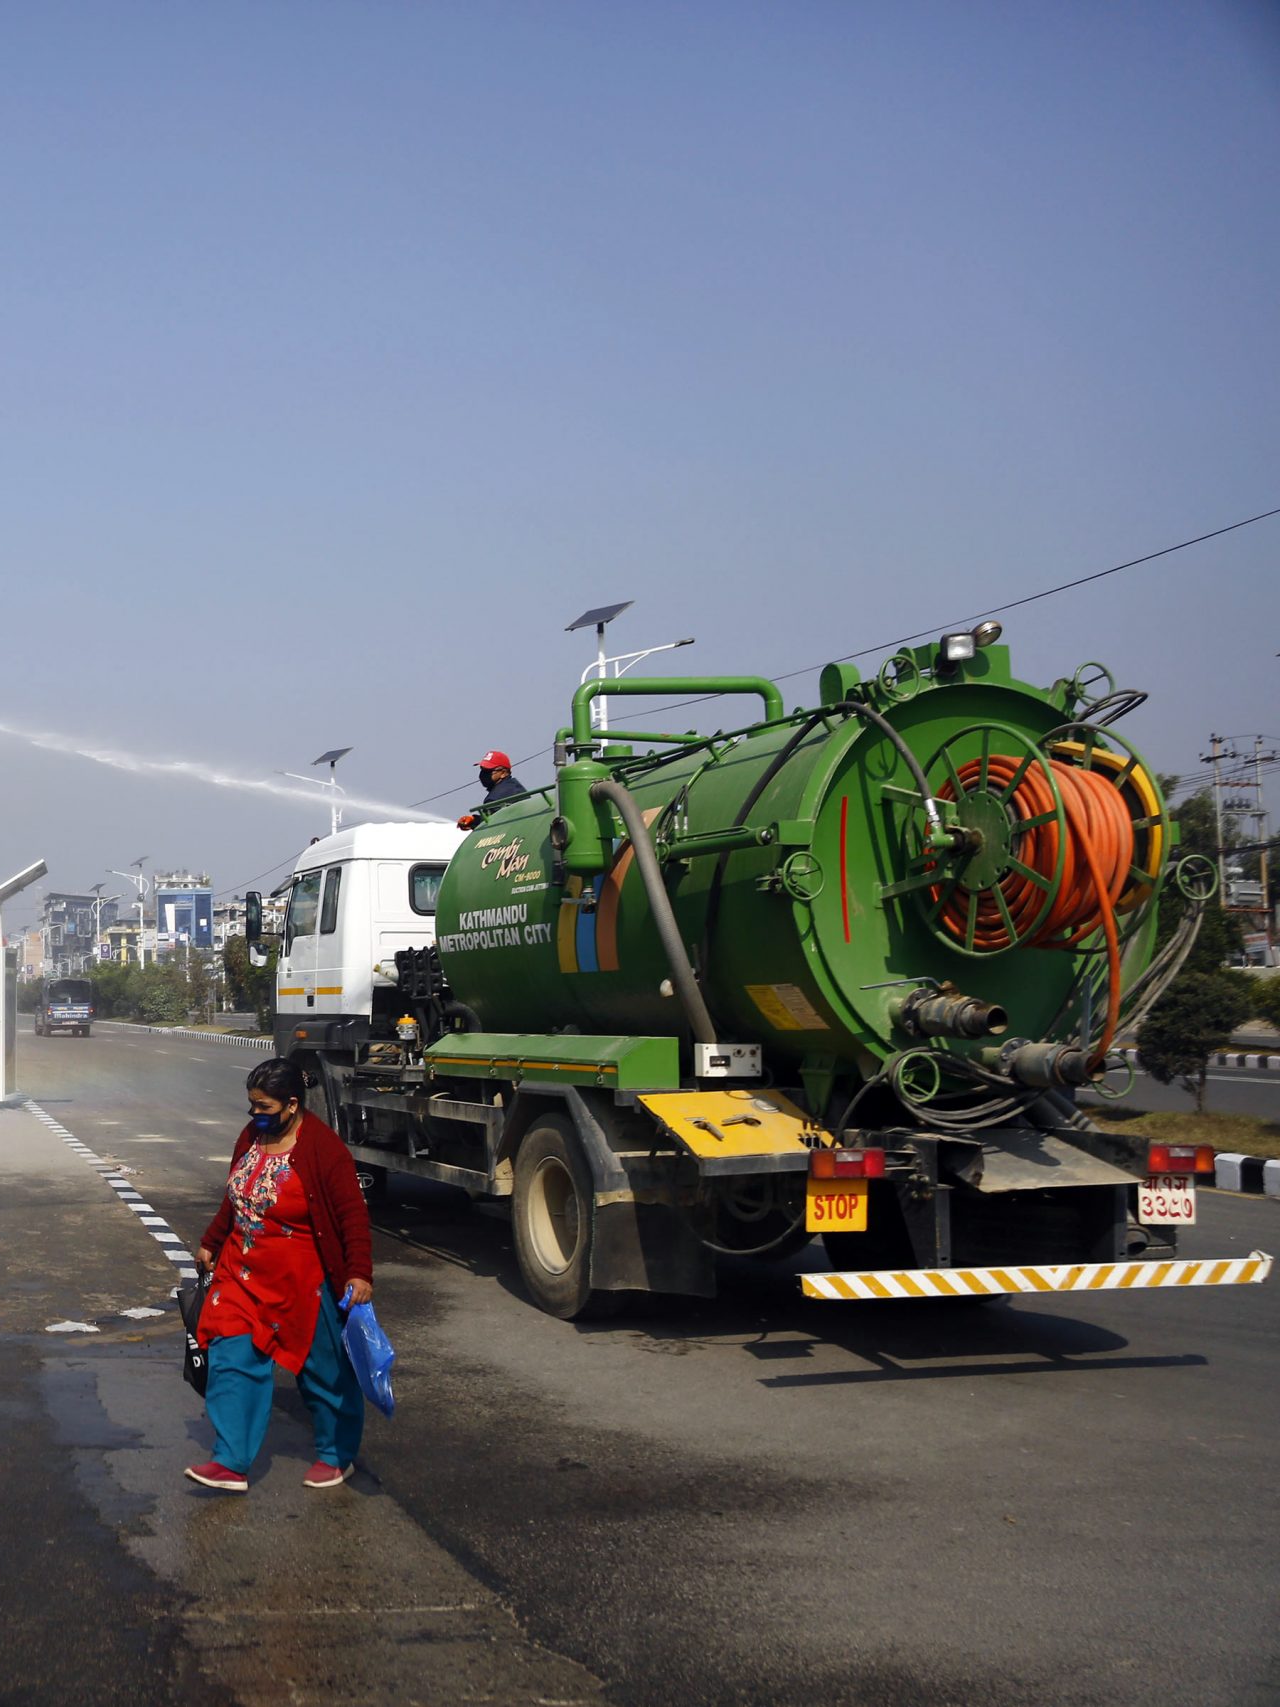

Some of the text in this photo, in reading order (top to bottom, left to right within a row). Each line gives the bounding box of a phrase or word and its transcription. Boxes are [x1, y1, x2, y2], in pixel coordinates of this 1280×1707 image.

[481, 837, 524, 869] Combi
[459, 903, 527, 931] KATHMANDU
[439, 922, 551, 953] METROPOLITAN CITY
[813, 1193, 859, 1221] STOP
